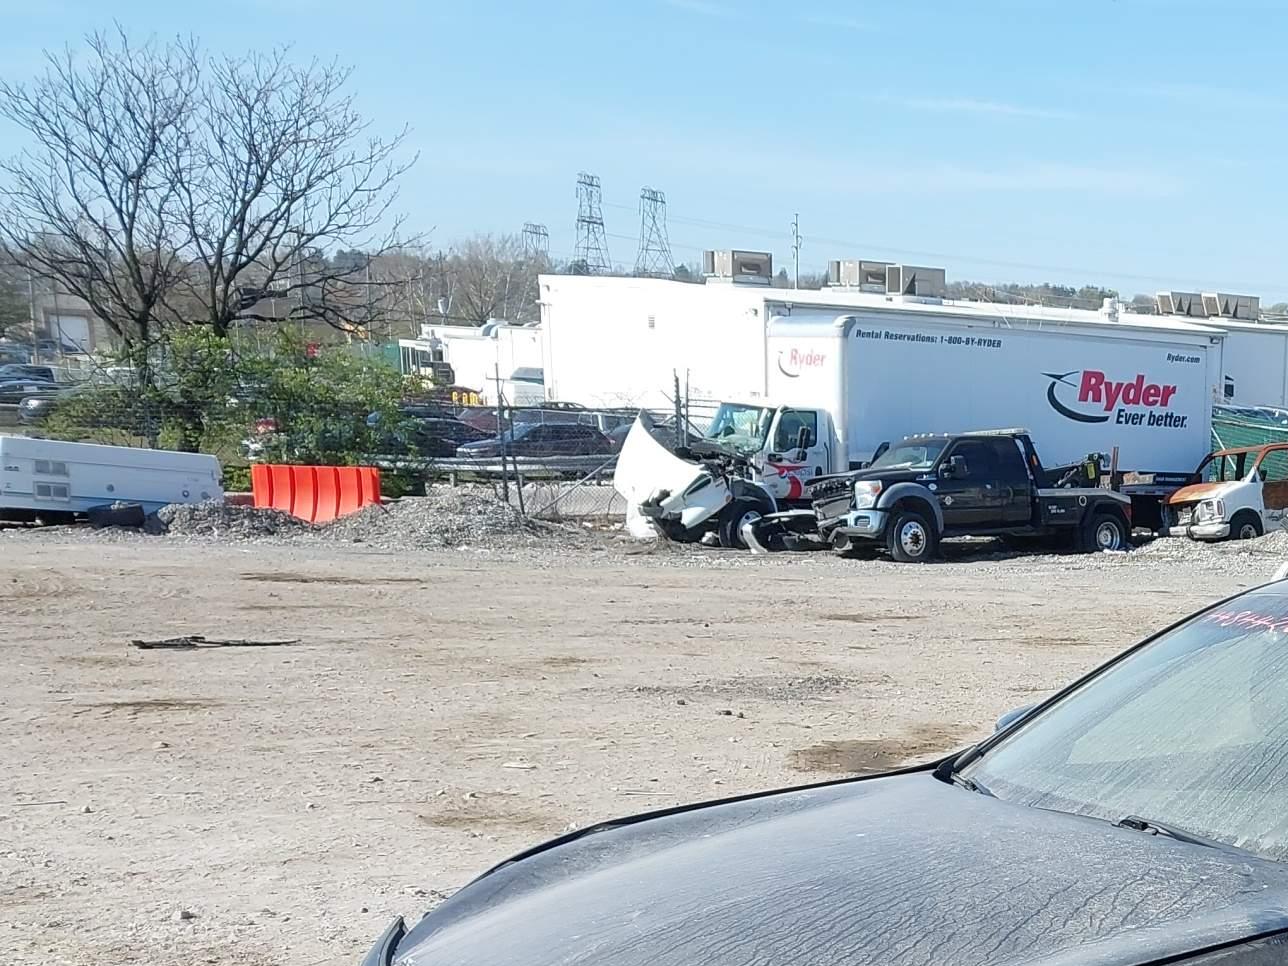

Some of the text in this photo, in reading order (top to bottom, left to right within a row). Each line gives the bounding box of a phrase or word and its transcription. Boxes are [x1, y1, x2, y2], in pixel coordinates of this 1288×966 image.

[856, 329, 1002, 348] Rental Reservations: 1-800-BY-RYDER
[790, 348, 827, 370] Ryder
[1166, 353, 1201, 364] Ryder.com
[1078, 370, 1177, 411] Ryder
[1115, 409, 1188, 428] Ever better.
